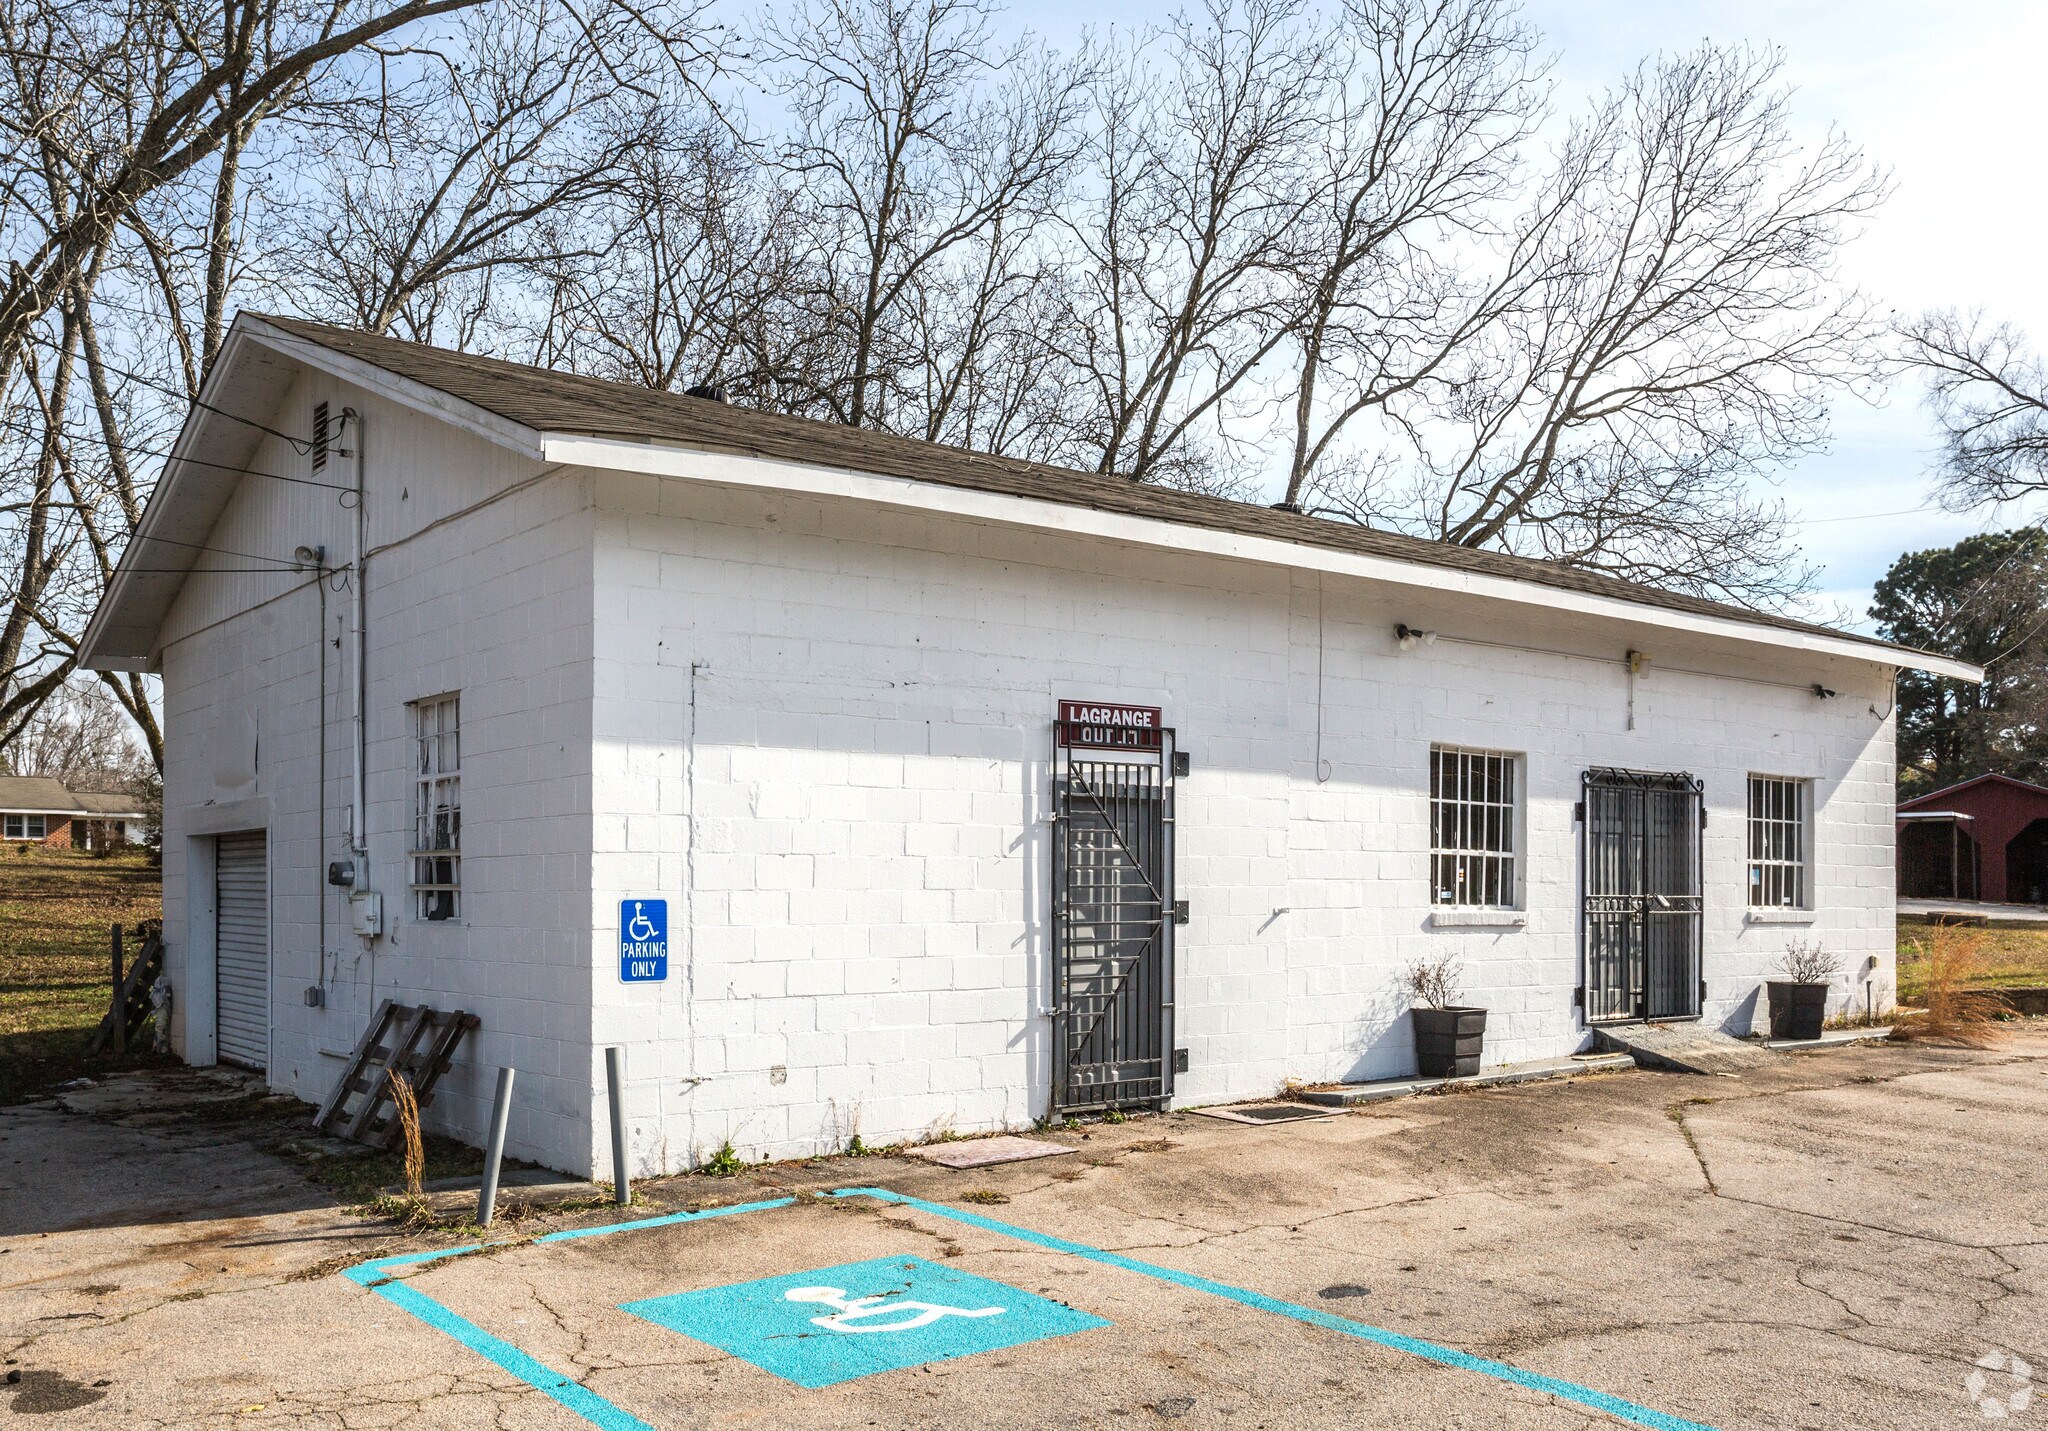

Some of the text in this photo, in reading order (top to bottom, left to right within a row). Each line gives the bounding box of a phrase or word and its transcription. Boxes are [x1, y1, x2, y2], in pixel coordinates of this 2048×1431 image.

[1070, 706, 1152, 727] LAGRANGE
[622, 941, 666, 958] PARKING
[631, 960, 657, 977] ONLY
